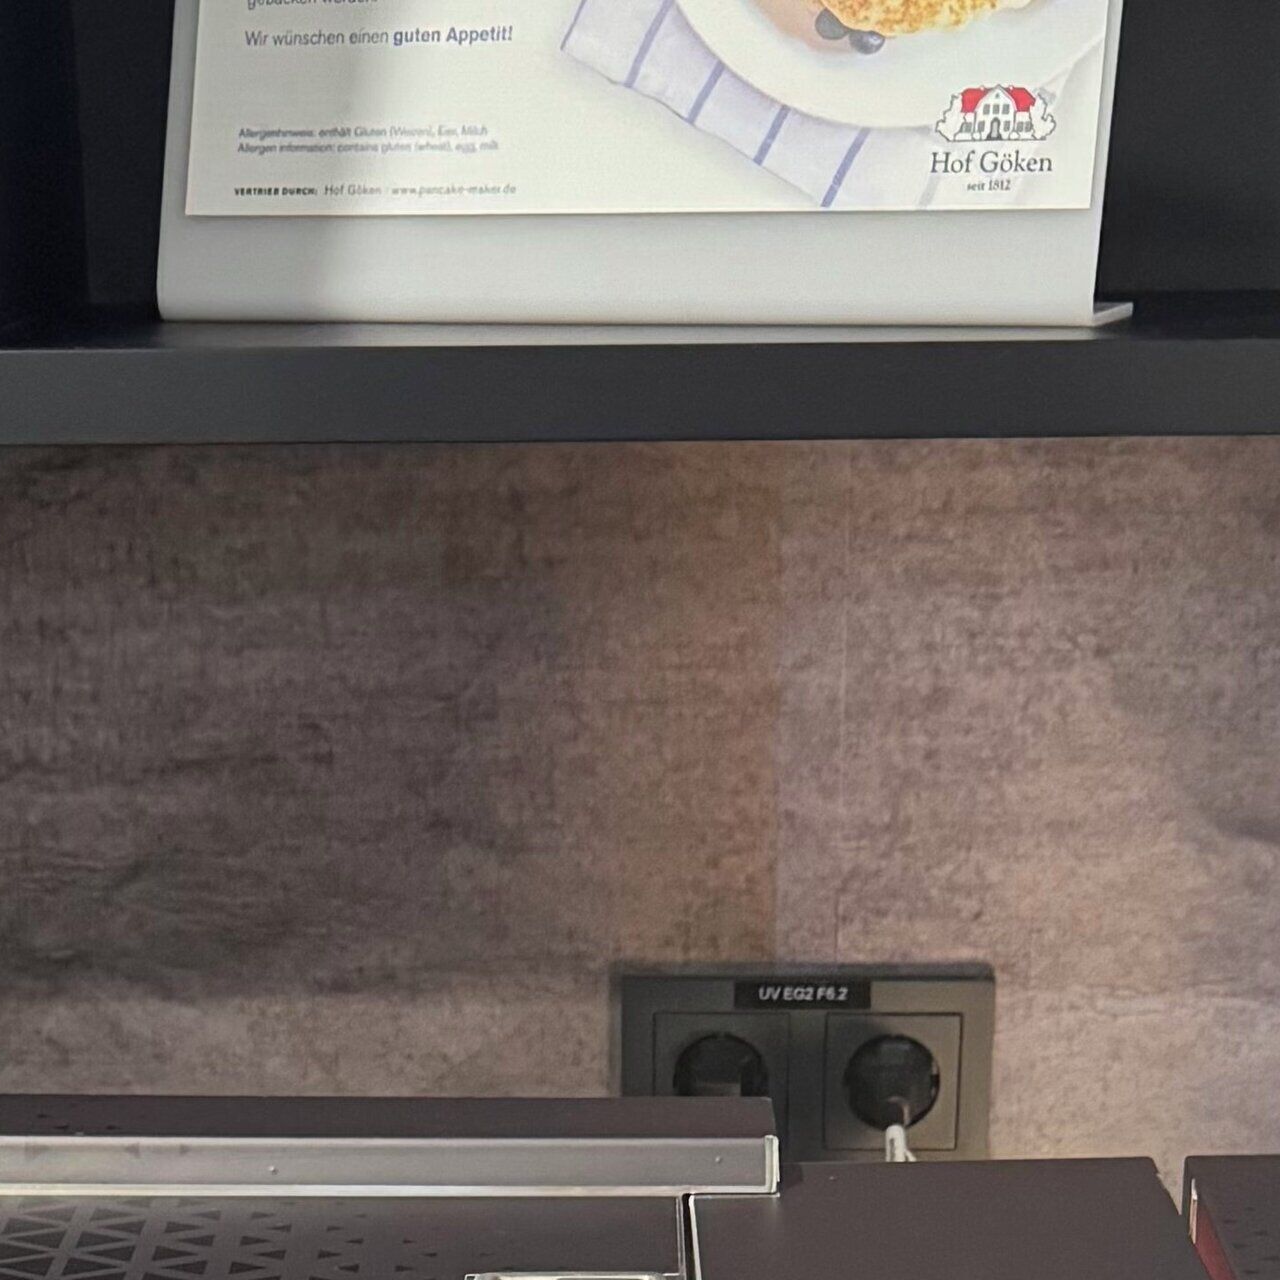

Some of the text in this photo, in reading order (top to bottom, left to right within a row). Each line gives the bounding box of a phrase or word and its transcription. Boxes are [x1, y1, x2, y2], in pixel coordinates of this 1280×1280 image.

[245, 25, 513, 46] Wir wünschen einen guten Appetit!
[930, 150, 1052, 173] Hof Göken
[966, 179, 1011, 192] seit 1812
[758, 986, 781, 1001] UV
